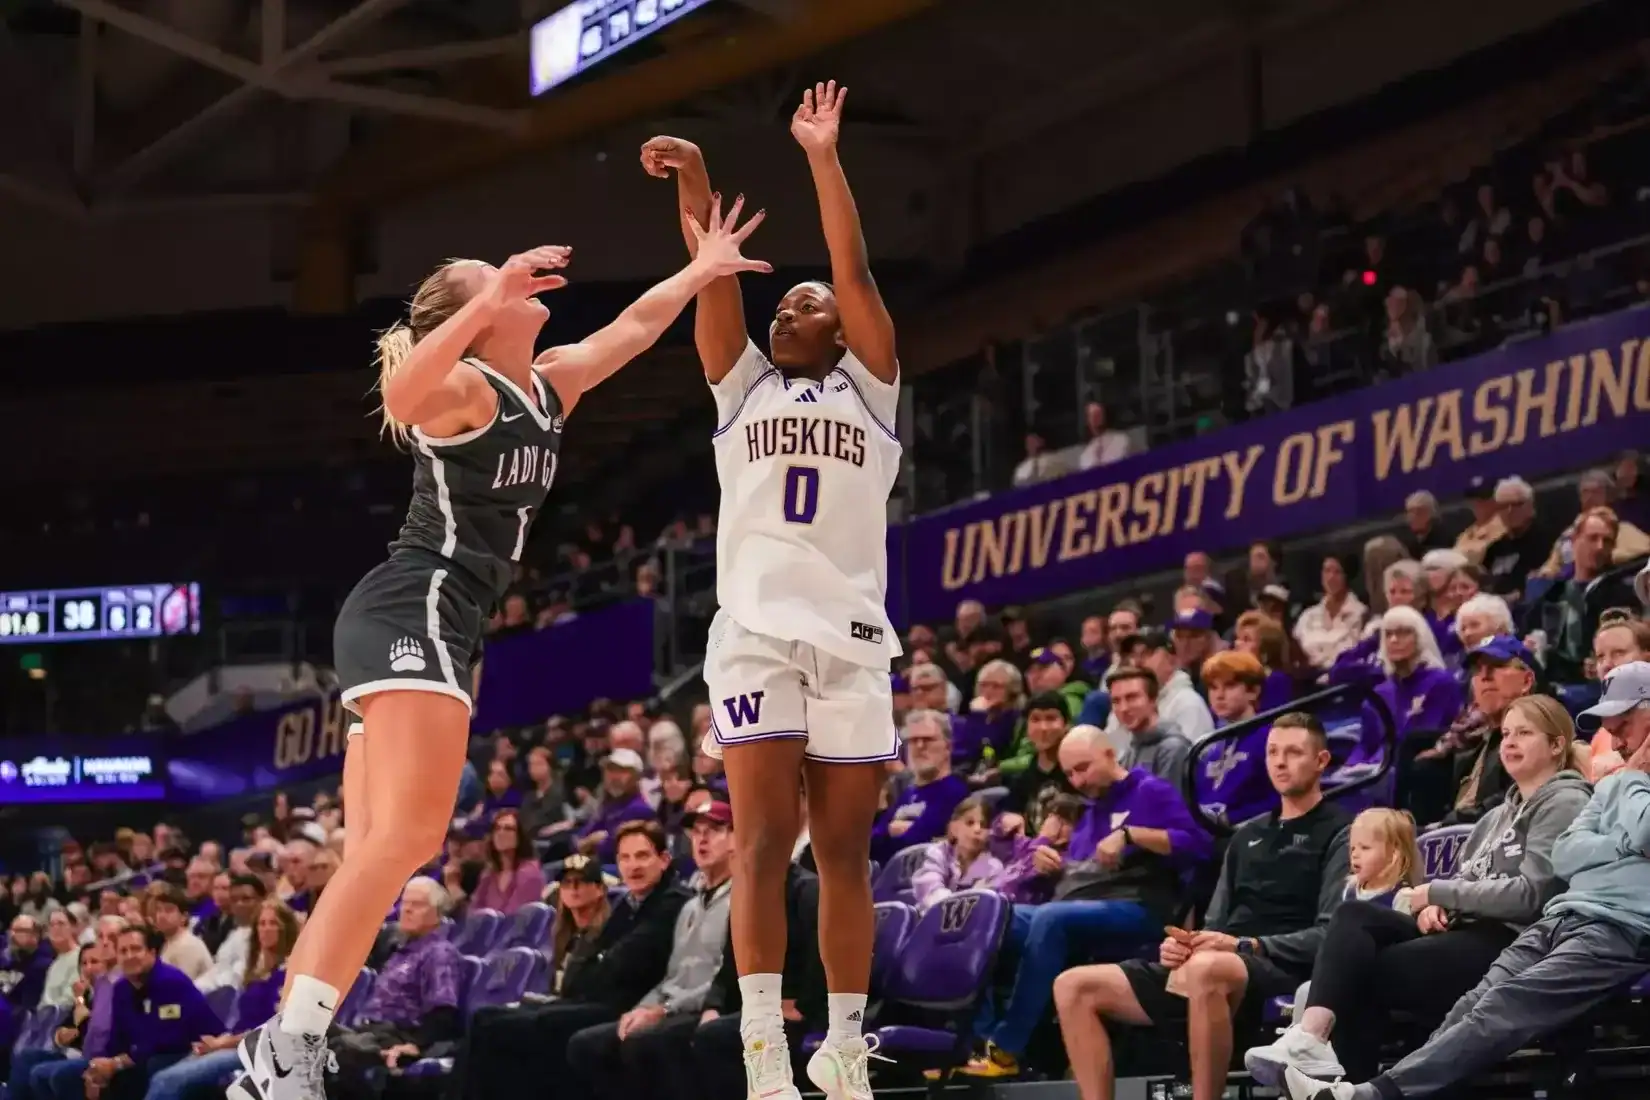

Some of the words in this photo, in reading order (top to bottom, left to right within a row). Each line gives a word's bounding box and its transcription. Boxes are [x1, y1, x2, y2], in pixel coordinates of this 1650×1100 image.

[745, 416, 866, 468] HUSKIES
[491, 445, 539, 489] LADY
[783, 464, 820, 524] 0
[941, 444, 1265, 590] UNIVERSITY
[1272, 419, 1355, 506] OF
[723, 690, 765, 728] W
[273, 708, 315, 770] GO
[1424, 833, 1470, 877] W
[940, 895, 980, 933] W
